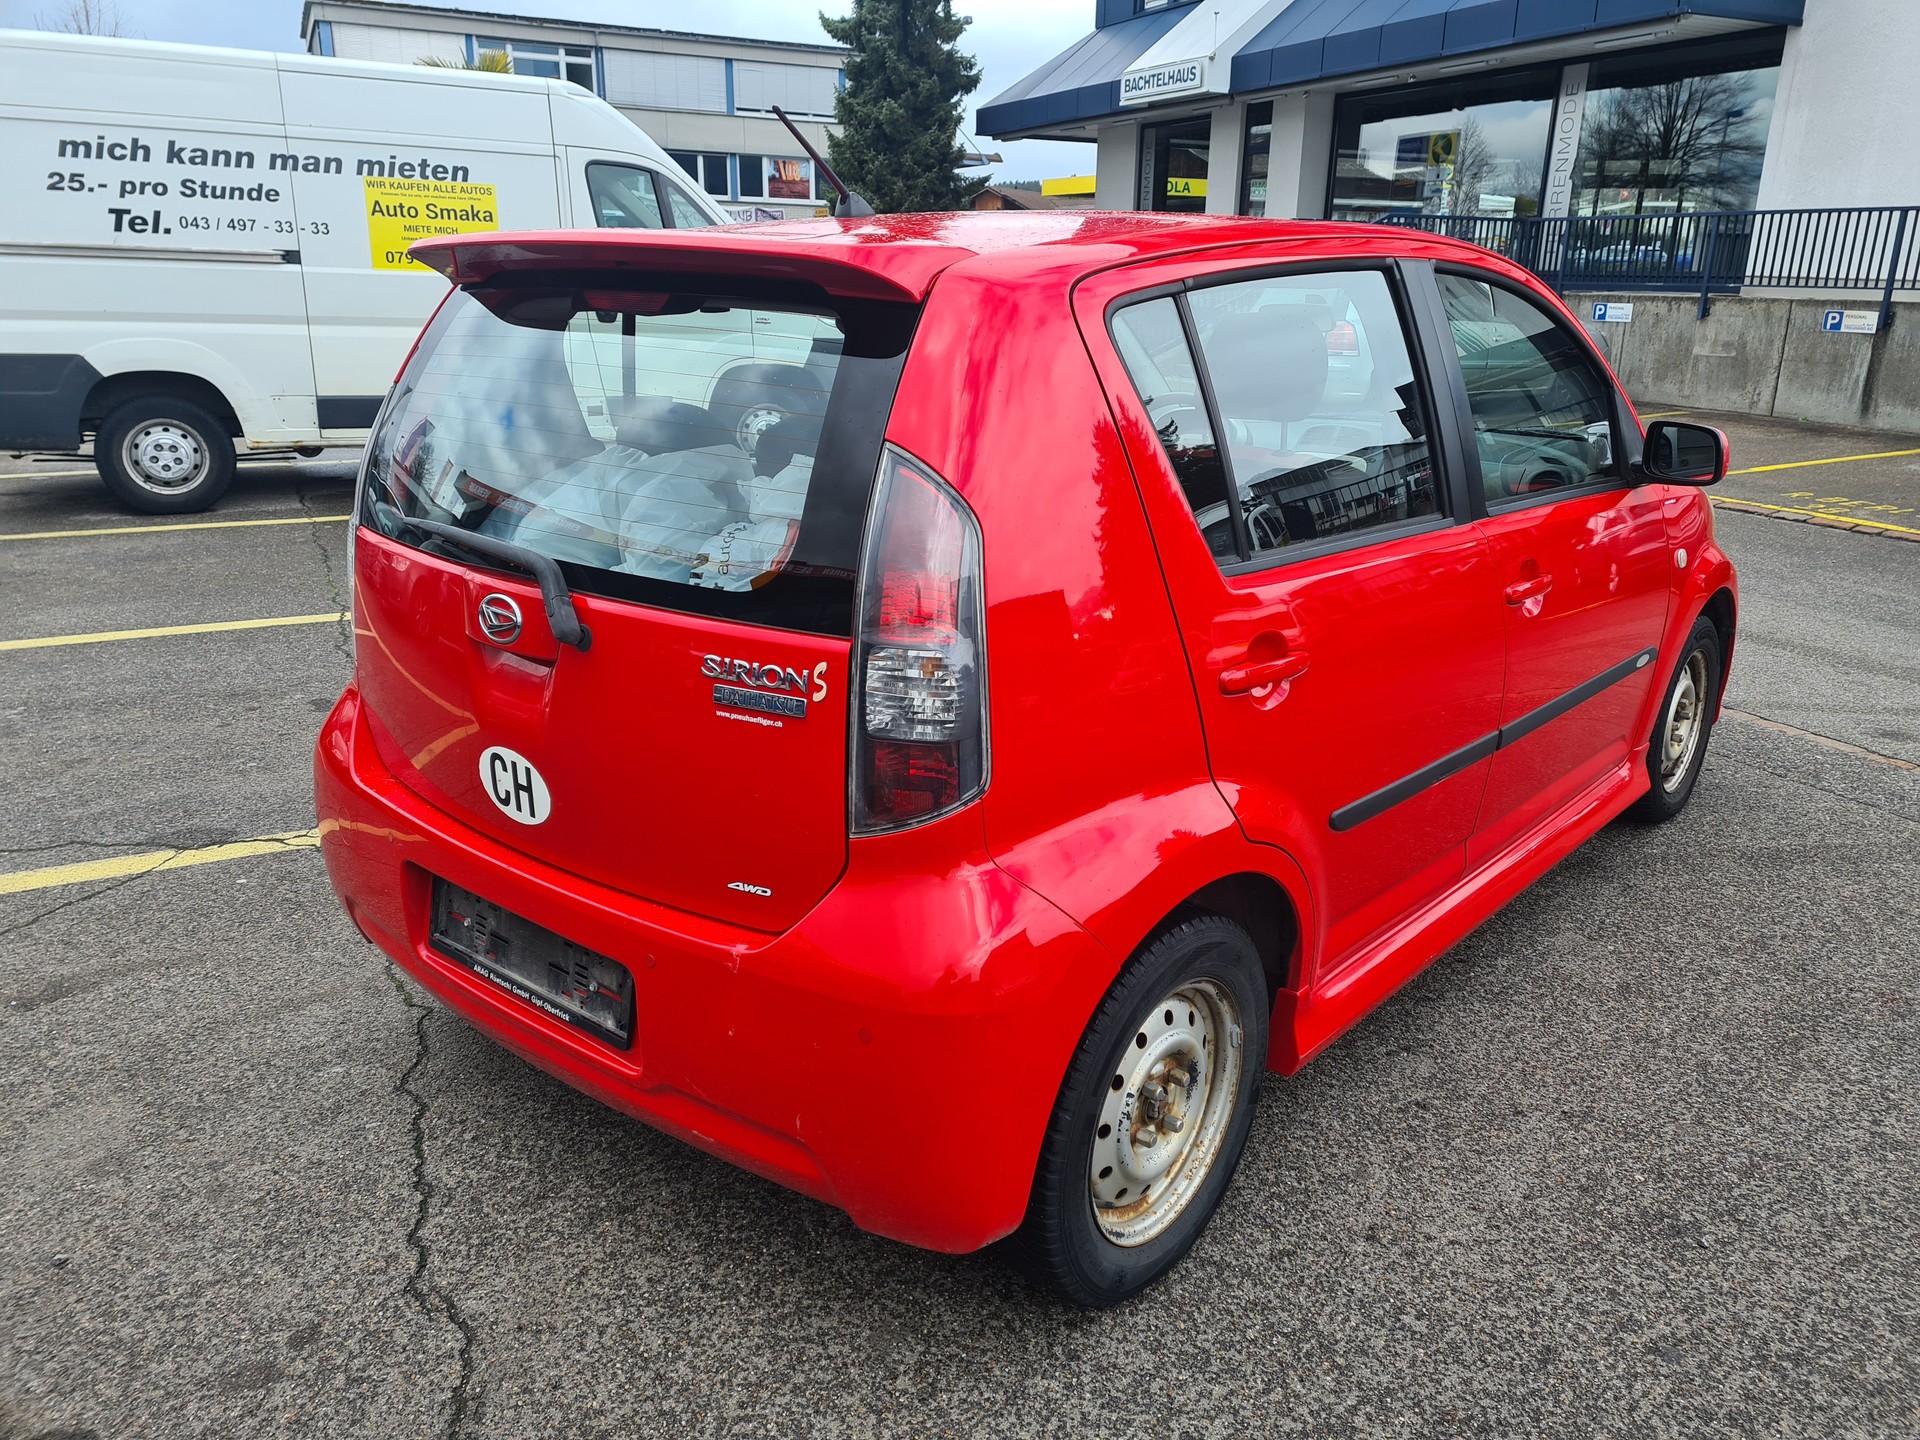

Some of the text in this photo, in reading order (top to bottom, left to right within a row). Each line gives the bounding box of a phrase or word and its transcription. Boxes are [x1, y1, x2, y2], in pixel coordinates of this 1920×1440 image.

[1124, 66, 1197, 93] BACHTELHAUS
[57, 135, 469, 182] mich kann man mieten
[46, 172, 281, 202] 25.- pro Stunde
[366, 180, 492, 196] WIR KAUFEN ALLE AUTOS
[108, 208, 172, 235] Tel.
[179, 216, 210, 230] 043
[216, 217, 220, 230] /
[226, 218, 256, 232] 497
[274, 220, 294, 234] 33
[311, 222, 330, 235] 33
[371, 200, 494, 222] Auto Smaka
[724, 209, 753, 221] LUB
[404, 224, 459, 235] MIETE MICH
[1595, 305, 1605, 320] P
[1826, 313, 1840, 330] P
[701, 654, 828, 702] SIRION S
[720, 687, 798, 715] DAIHATSU
[489, 751, 536, 819] CH
[727, 881, 772, 897] 4WD
[473, 964, 489, 978] ARAG
[512, 985, 530, 1000] GmbH
[530, 995, 570, 1021] Gipf-Oberfrick
